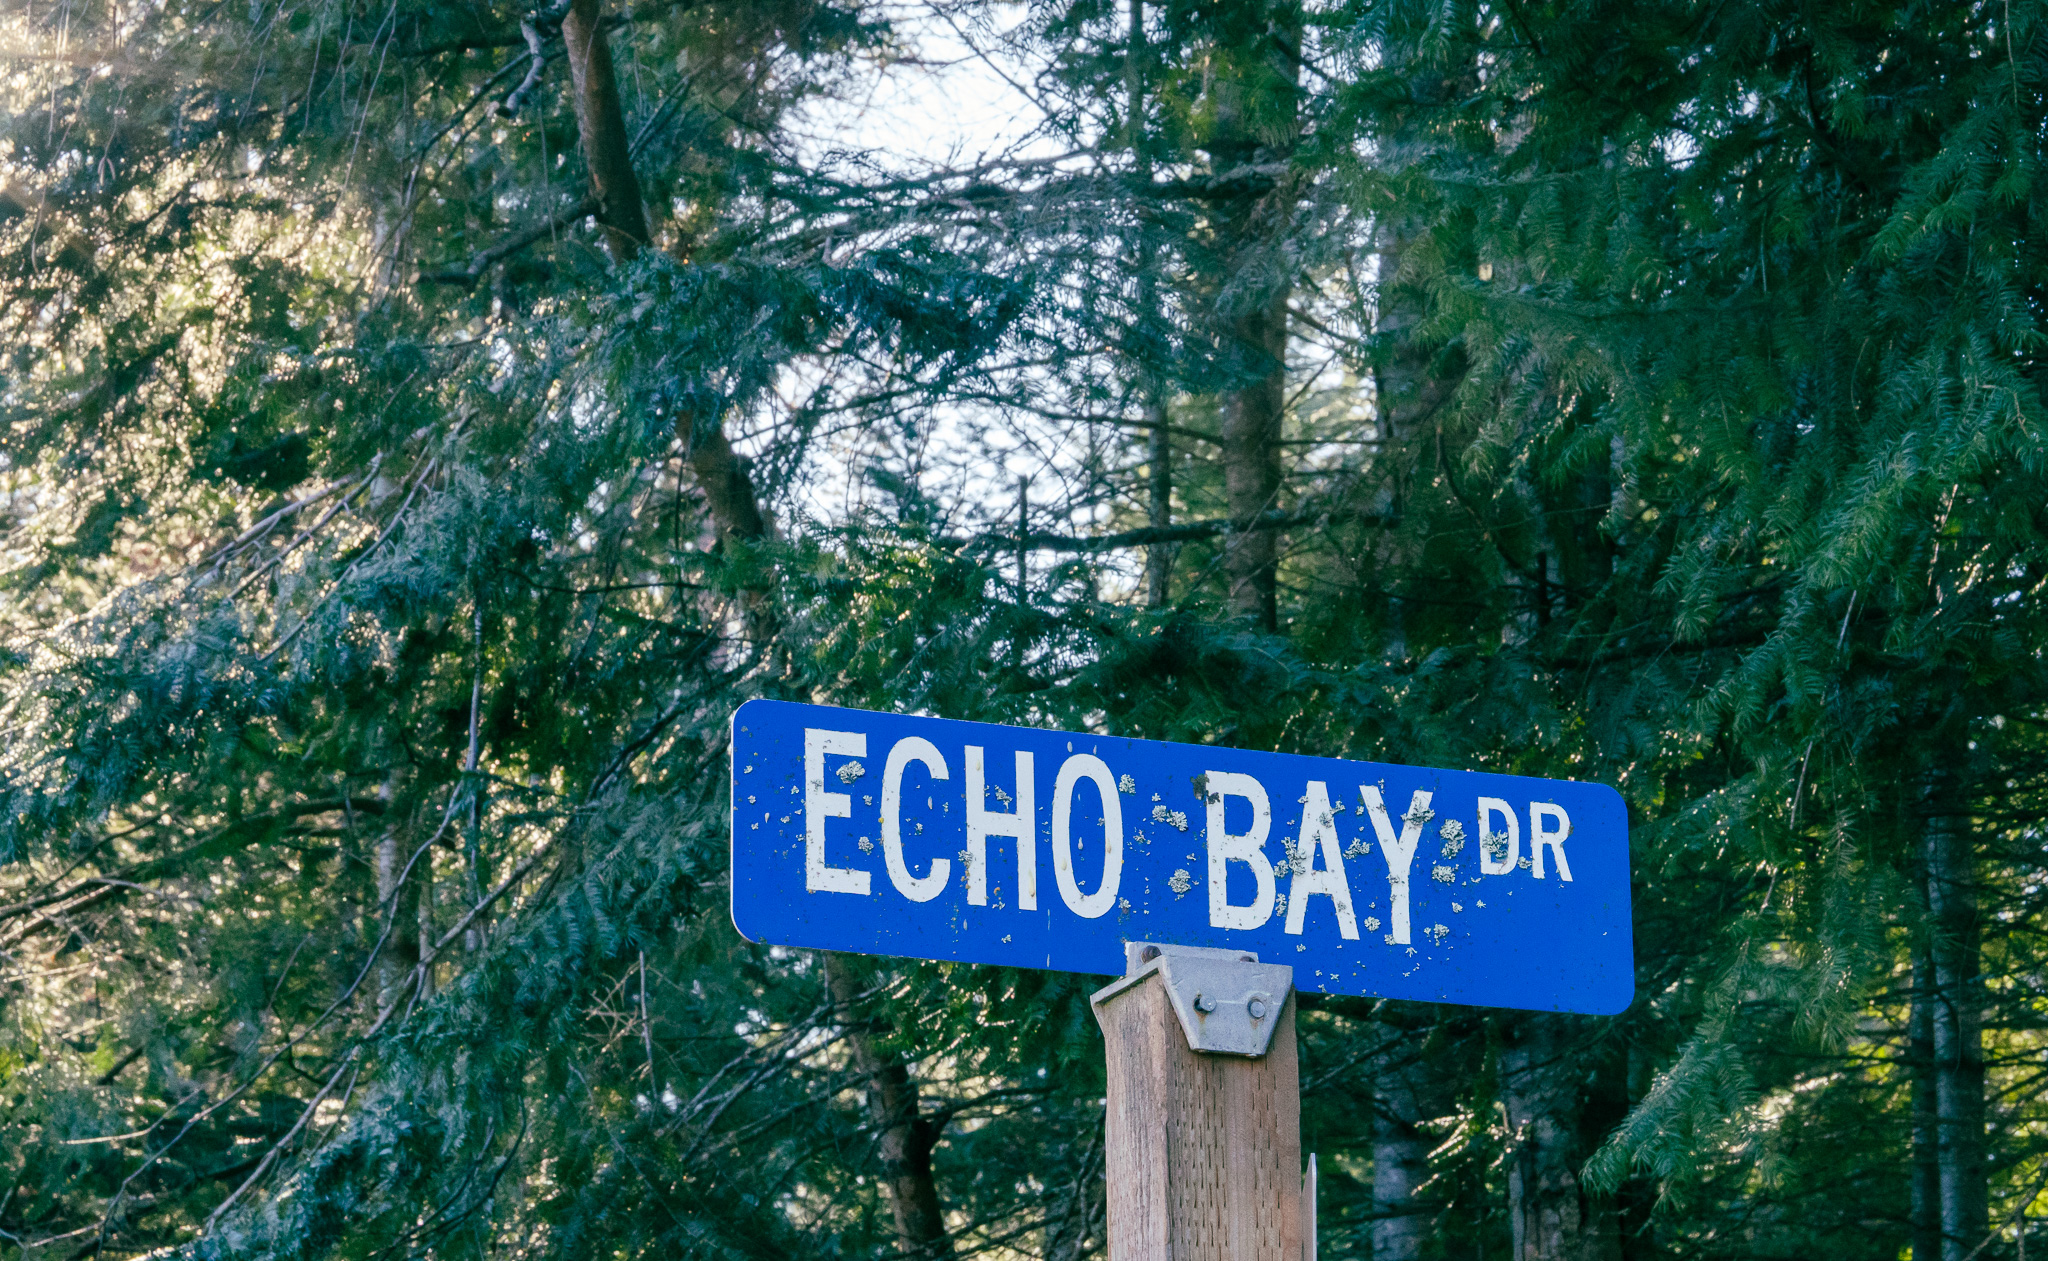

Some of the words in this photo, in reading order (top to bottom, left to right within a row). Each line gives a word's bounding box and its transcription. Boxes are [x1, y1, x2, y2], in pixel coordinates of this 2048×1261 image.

[804, 728, 1124, 919] ECHO
[1205, 770, 1433, 945] BAY
[1477, 797, 1573, 882] DR
